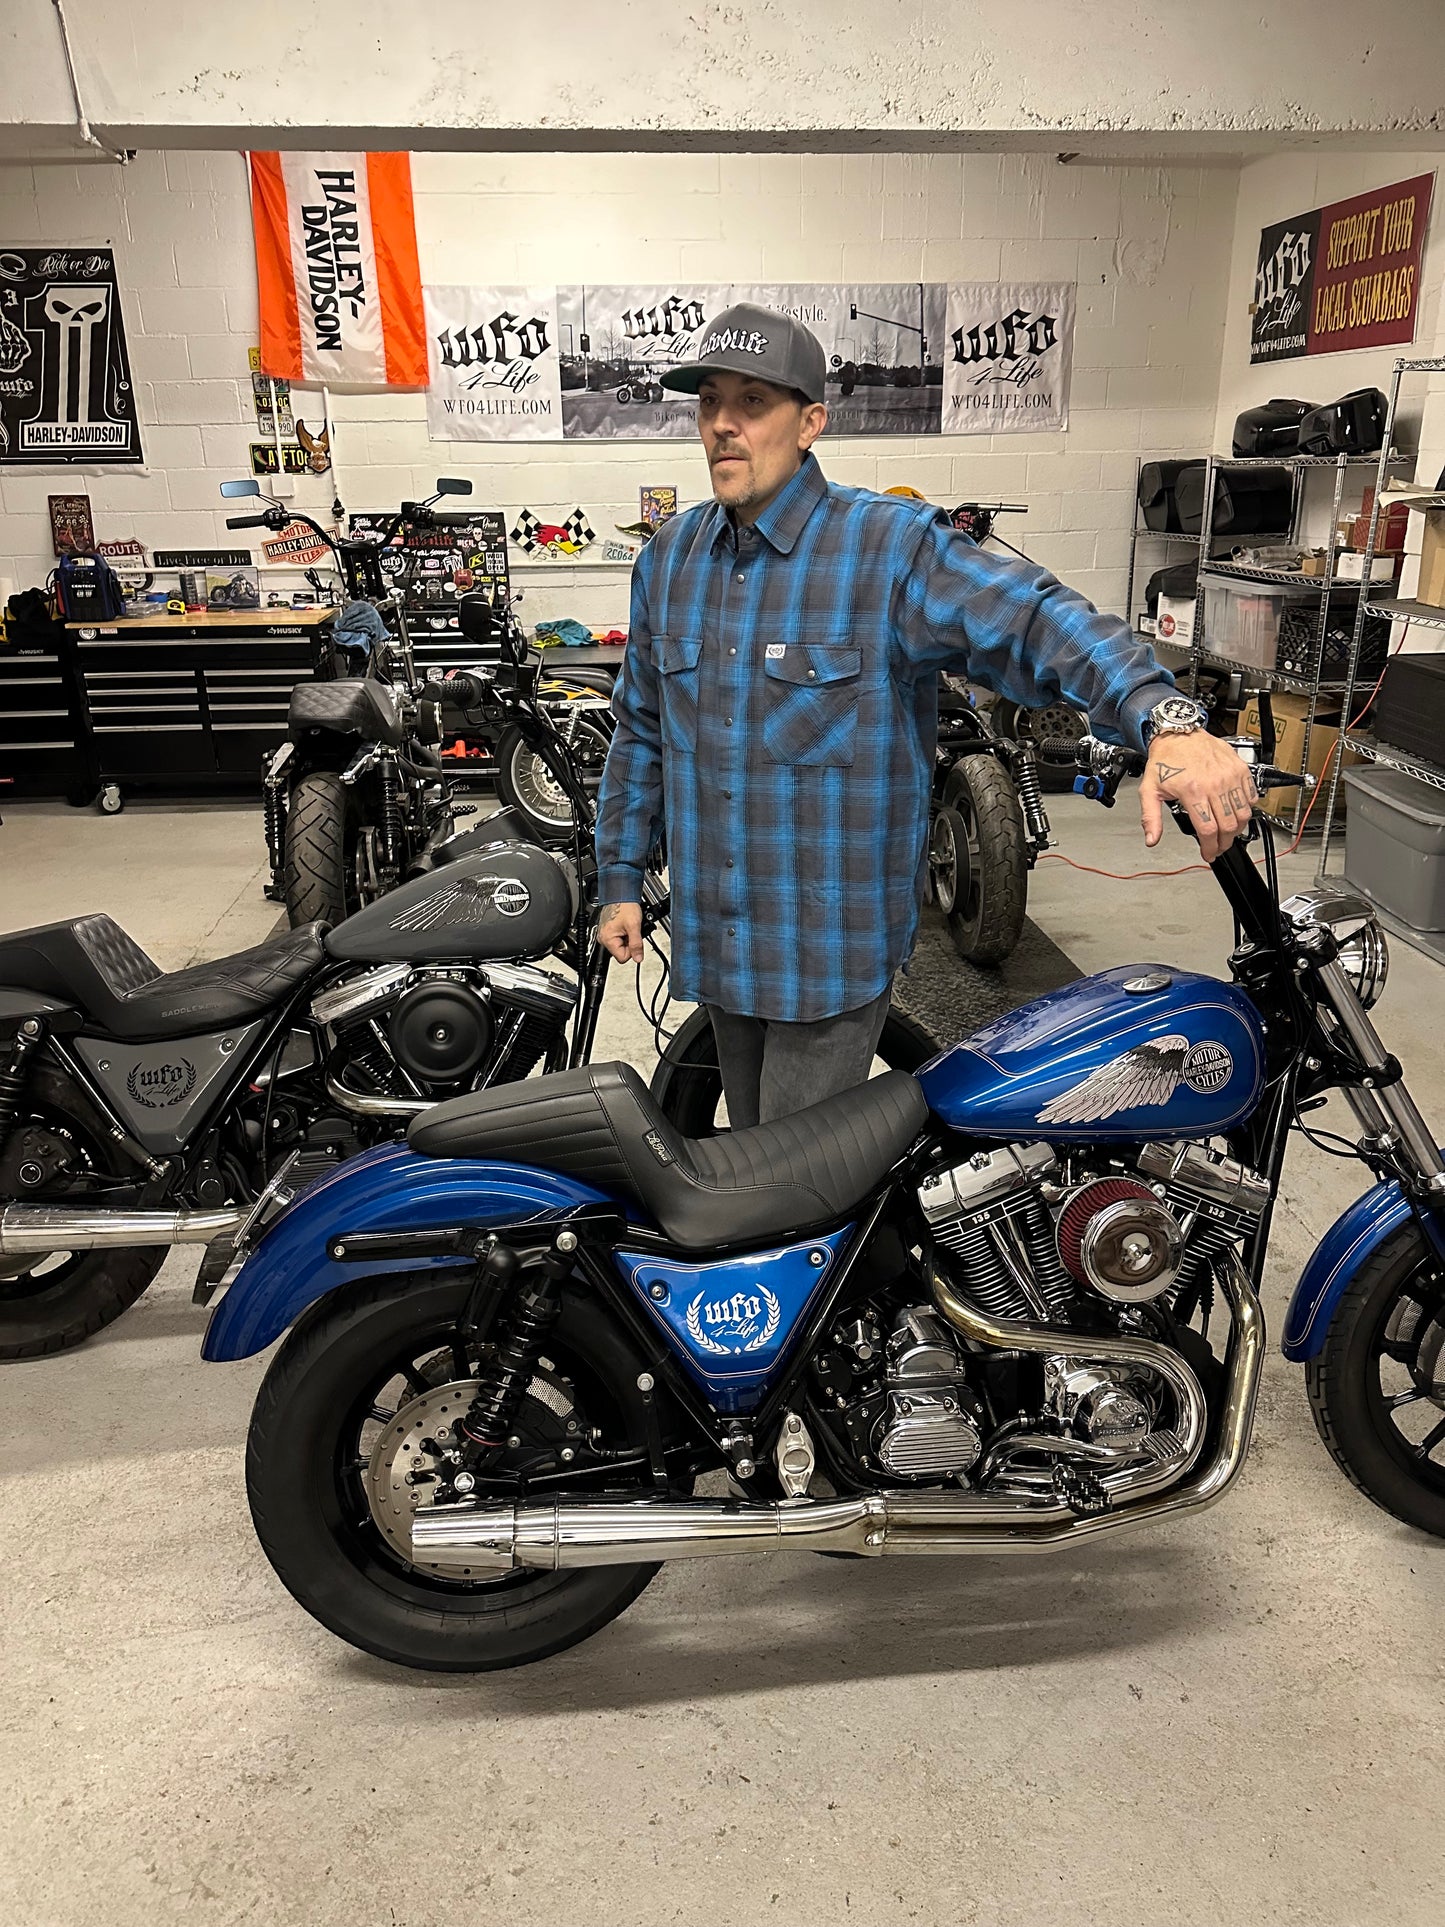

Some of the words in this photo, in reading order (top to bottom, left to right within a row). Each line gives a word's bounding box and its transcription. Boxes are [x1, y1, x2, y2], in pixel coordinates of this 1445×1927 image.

[1327, 206, 1381, 271] SUPPORT
[1381, 195, 1415, 255] YOUR
[313, 169, 366, 320] HARLEY-
[34, 252, 68, 278] Ride
[69, 258, 83, 271] or
[82, 254, 111, 277] Die
[301, 204, 343, 351] DAVIDSON
[1314, 281, 1347, 335] LOCAL
[1349, 264, 1414, 328] SCUMBAGS
[1256, 311, 1271, 335] 4
[1268, 289, 1302, 330] Life
[636, 341, 656, 356] 4
[653, 332, 698, 358] Life
[458, 371, 485, 391] 4
[482, 360, 541, 394] Life
[966, 366, 993, 386] 4
[988, 355, 1044, 388] Life
[443, 399, 552, 415] WFO4LIFE.COM
[951, 394, 1053, 409] WFO4LIFE.COM
[28, 426, 123, 443] HARLEY-DAVIDSON
[283, 524, 313, 538] MOTOR
[100, 543, 139, 556] ROUTE
[266, 531, 336, 556] HARLEY-DAVIDN
[158, 555, 181, 565] Live
[185, 554, 210, 564] Free
[229, 554, 249, 564] Die
[290, 547, 320, 563] CYCLES
[1191, 1047, 1221, 1066] MOTOR
[1195, 1069, 1225, 1087] CYCLES
[971, 1212, 991, 1226] 135
[1208, 1205, 1226, 1218] 135
[710, 1324, 727, 1337] 4
[724, 1317, 759, 1338] Life
